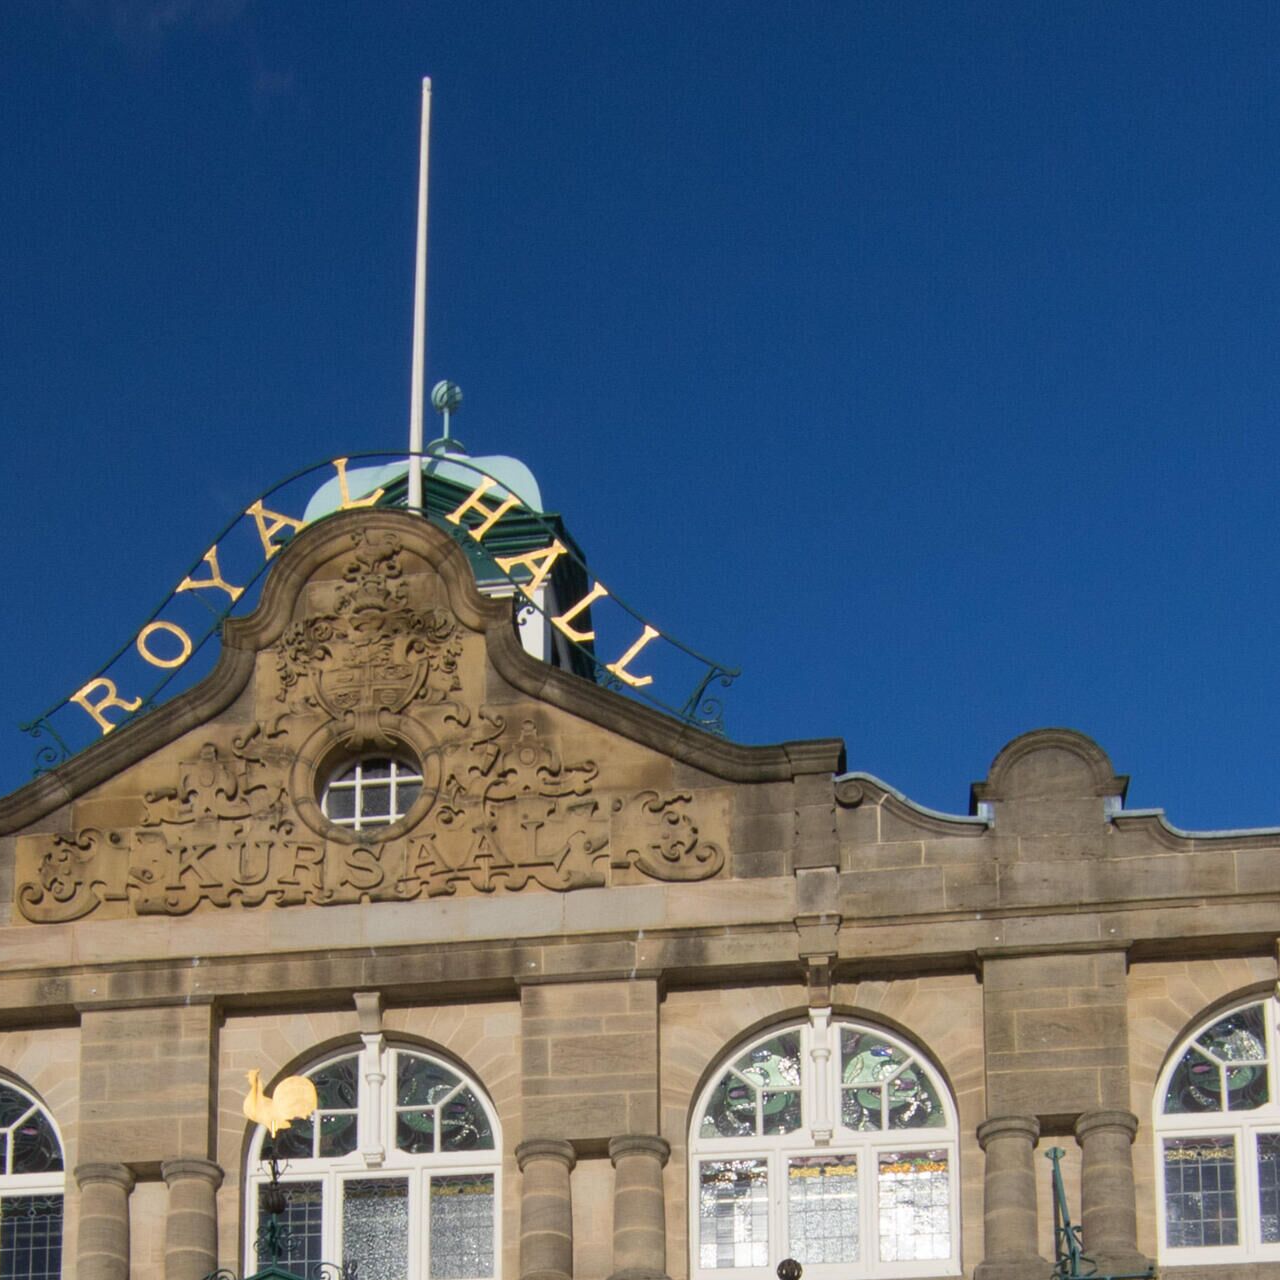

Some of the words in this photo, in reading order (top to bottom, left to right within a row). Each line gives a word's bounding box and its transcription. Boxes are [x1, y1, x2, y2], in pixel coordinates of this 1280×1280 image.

[70, 458, 385, 735] ROYAL
[446, 476, 662, 687] HALL
[164, 822, 573, 890] KURSAAL
